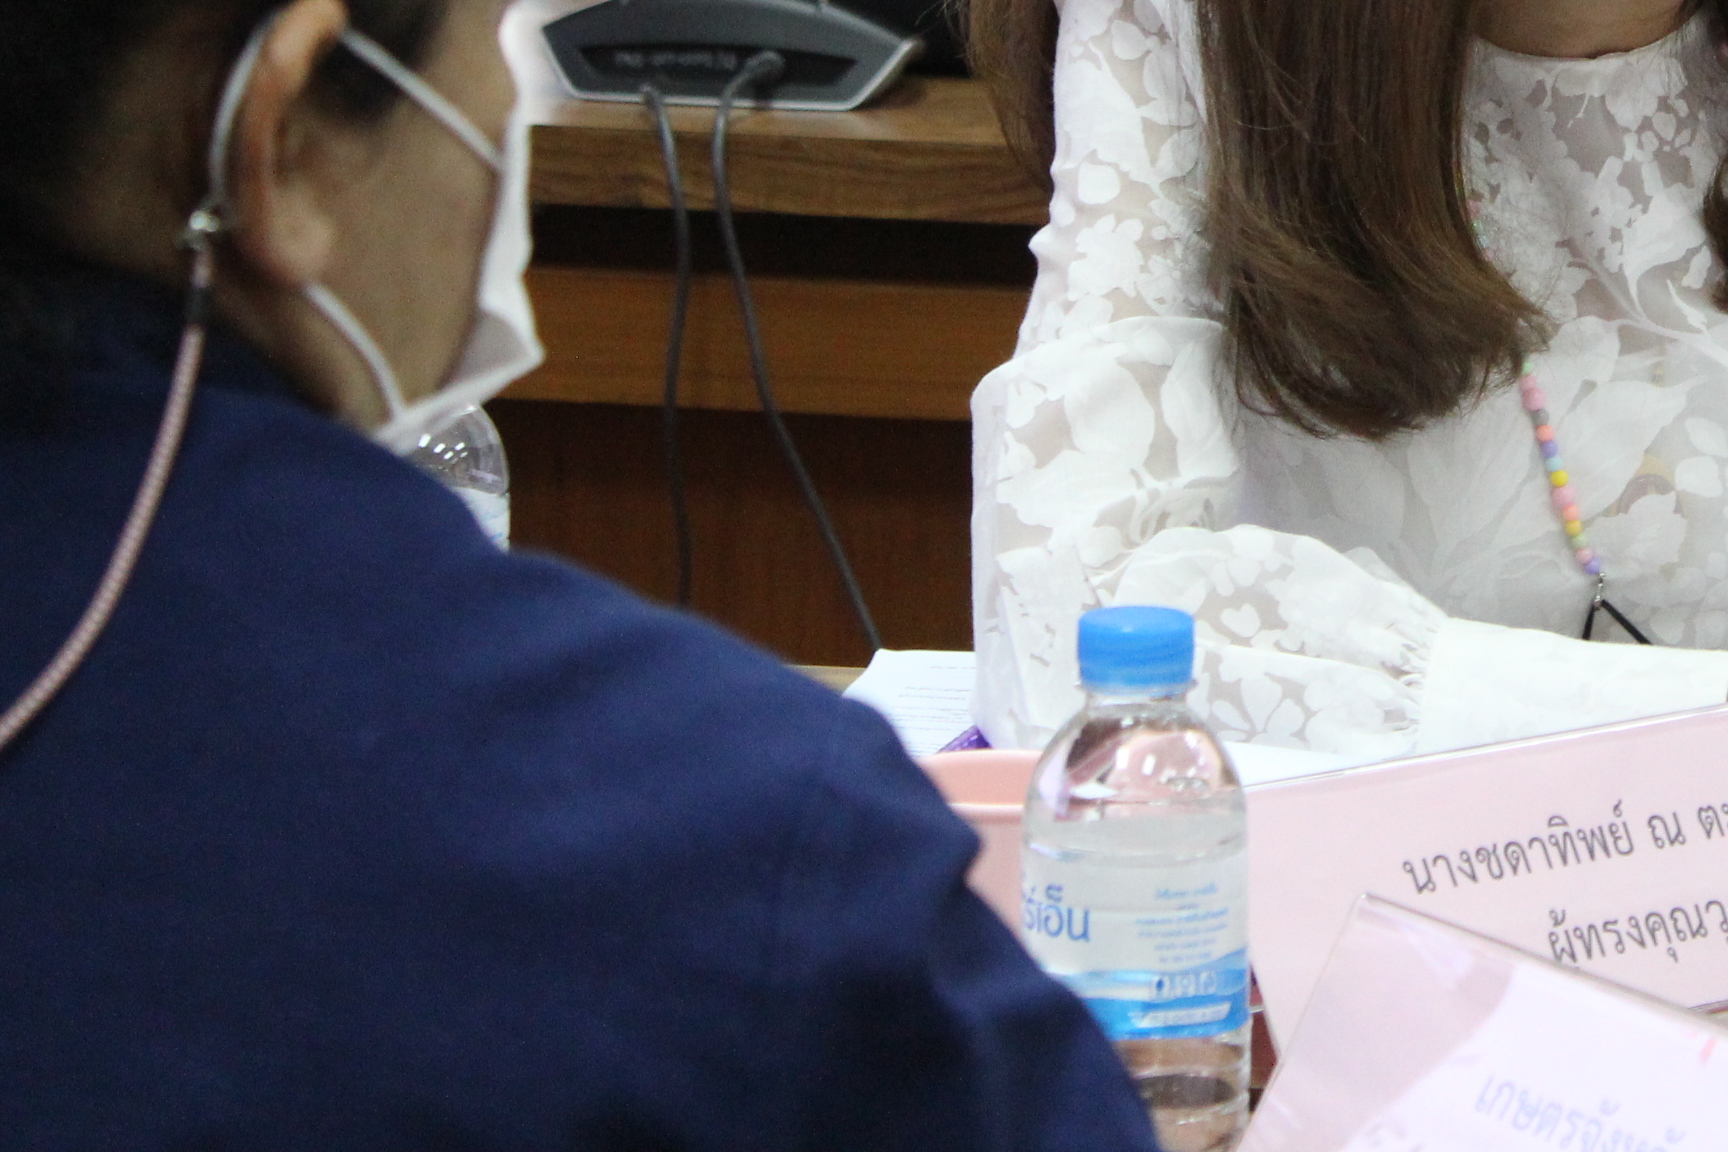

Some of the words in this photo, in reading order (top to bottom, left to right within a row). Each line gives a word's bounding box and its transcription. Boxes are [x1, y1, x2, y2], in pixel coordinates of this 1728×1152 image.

[1401, 798, 1634, 896] นางชดาทิพย์
[1645, 810, 1688, 850] ณ
